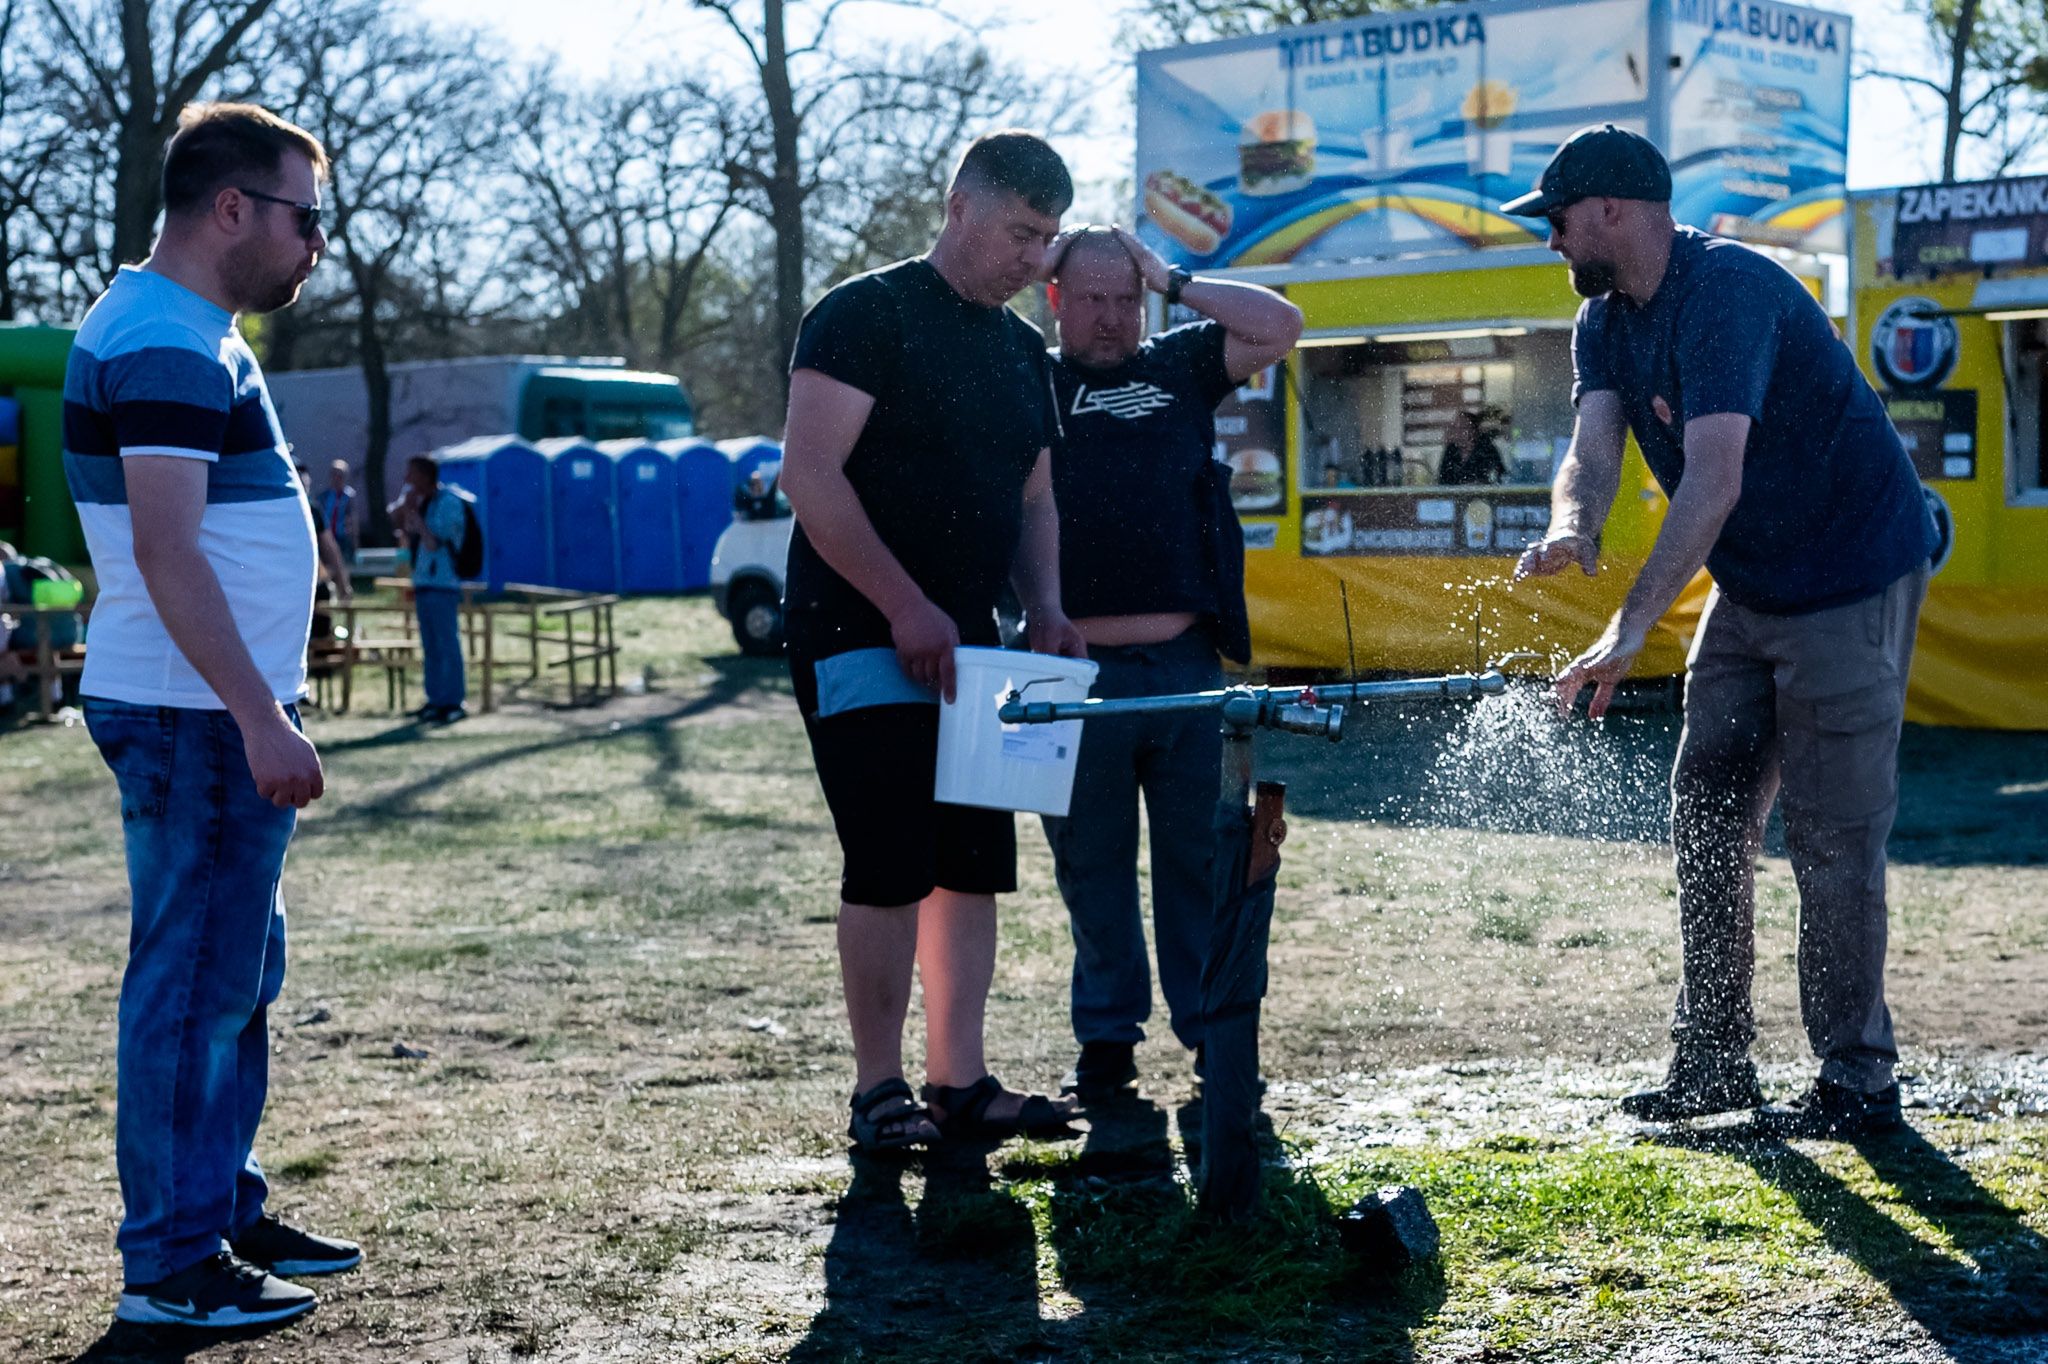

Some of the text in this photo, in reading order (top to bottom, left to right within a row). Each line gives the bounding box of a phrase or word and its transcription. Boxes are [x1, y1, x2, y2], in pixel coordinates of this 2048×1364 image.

[1279, 12, 1486, 69] MILABUDKA
[1677, 0, 1838, 53] MILABUDKA
[1900, 179, 2048, 224] ZAPIEKANK
